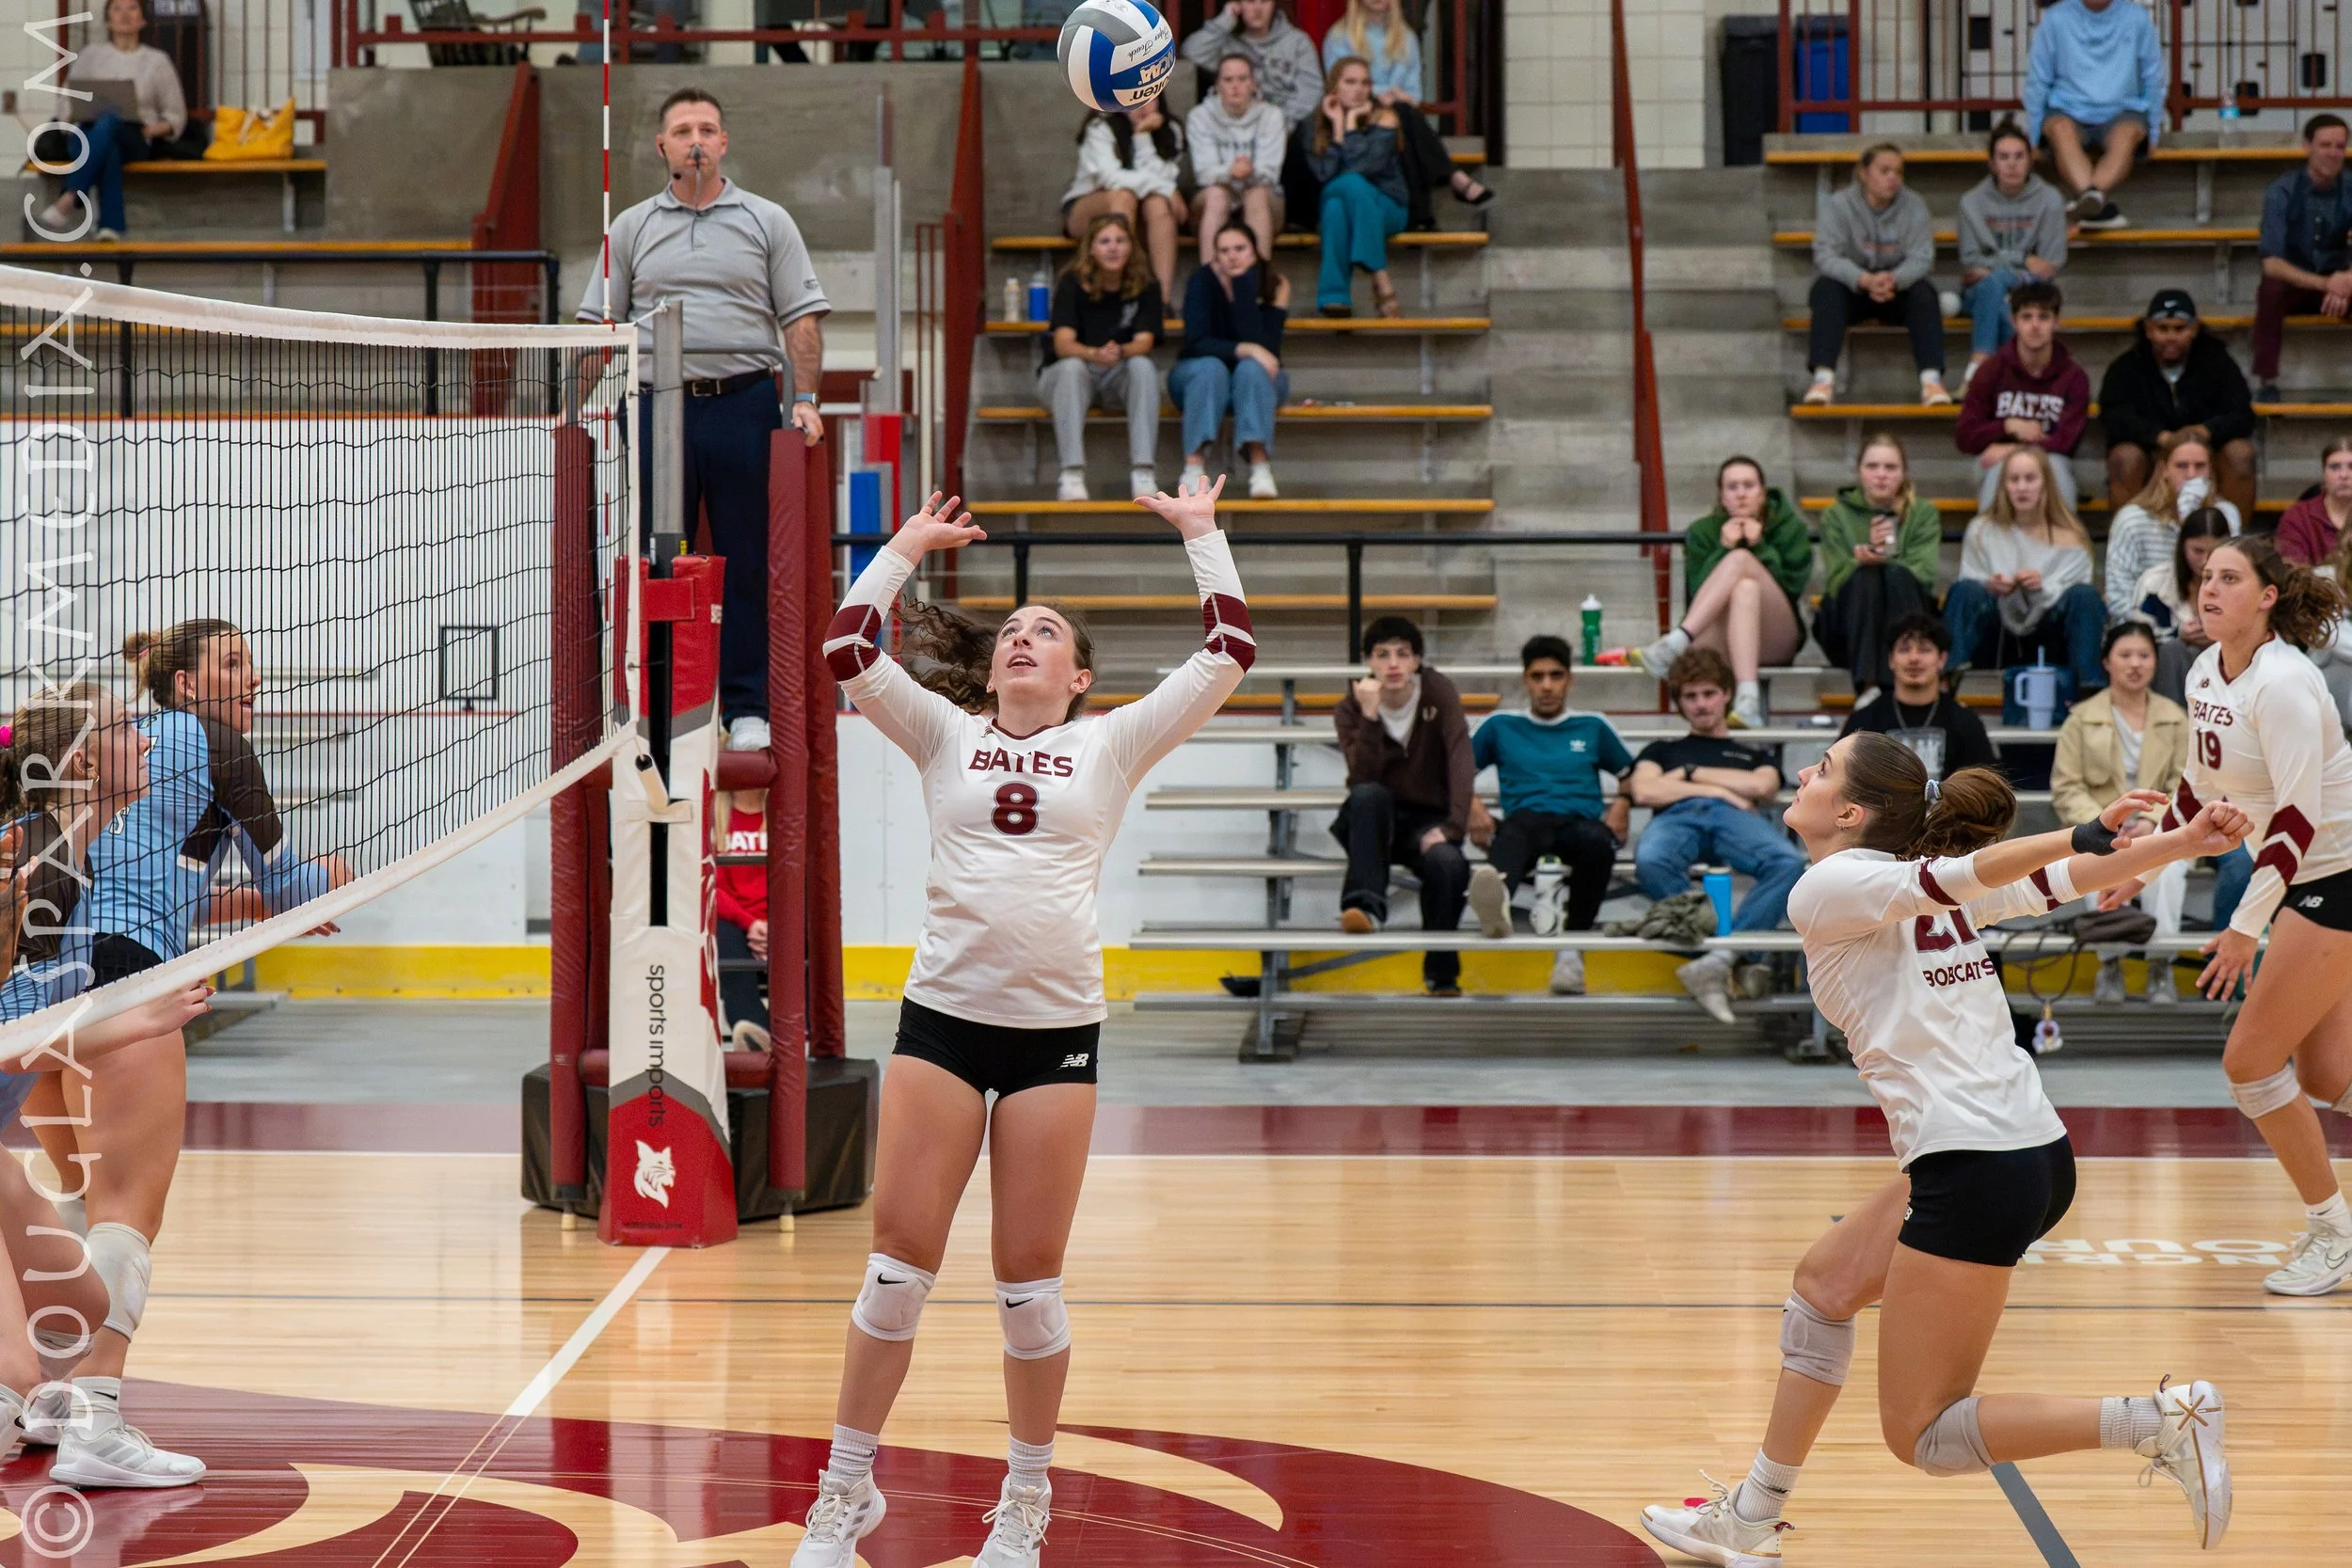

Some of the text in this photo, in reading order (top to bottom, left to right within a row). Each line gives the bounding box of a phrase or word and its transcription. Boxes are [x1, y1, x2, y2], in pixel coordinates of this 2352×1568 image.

[1127, 40, 1153, 63] Touch
[1133, 75, 1170, 101] olten
[2193, 701, 2233, 727] BATES
[968, 747, 1073, 778] BATES
[2196, 726, 2222, 770] 19
[991, 781, 1040, 836] 8
[1922, 958, 1995, 988] BOBCATS
[646, 964, 666, 1128] sports imports
